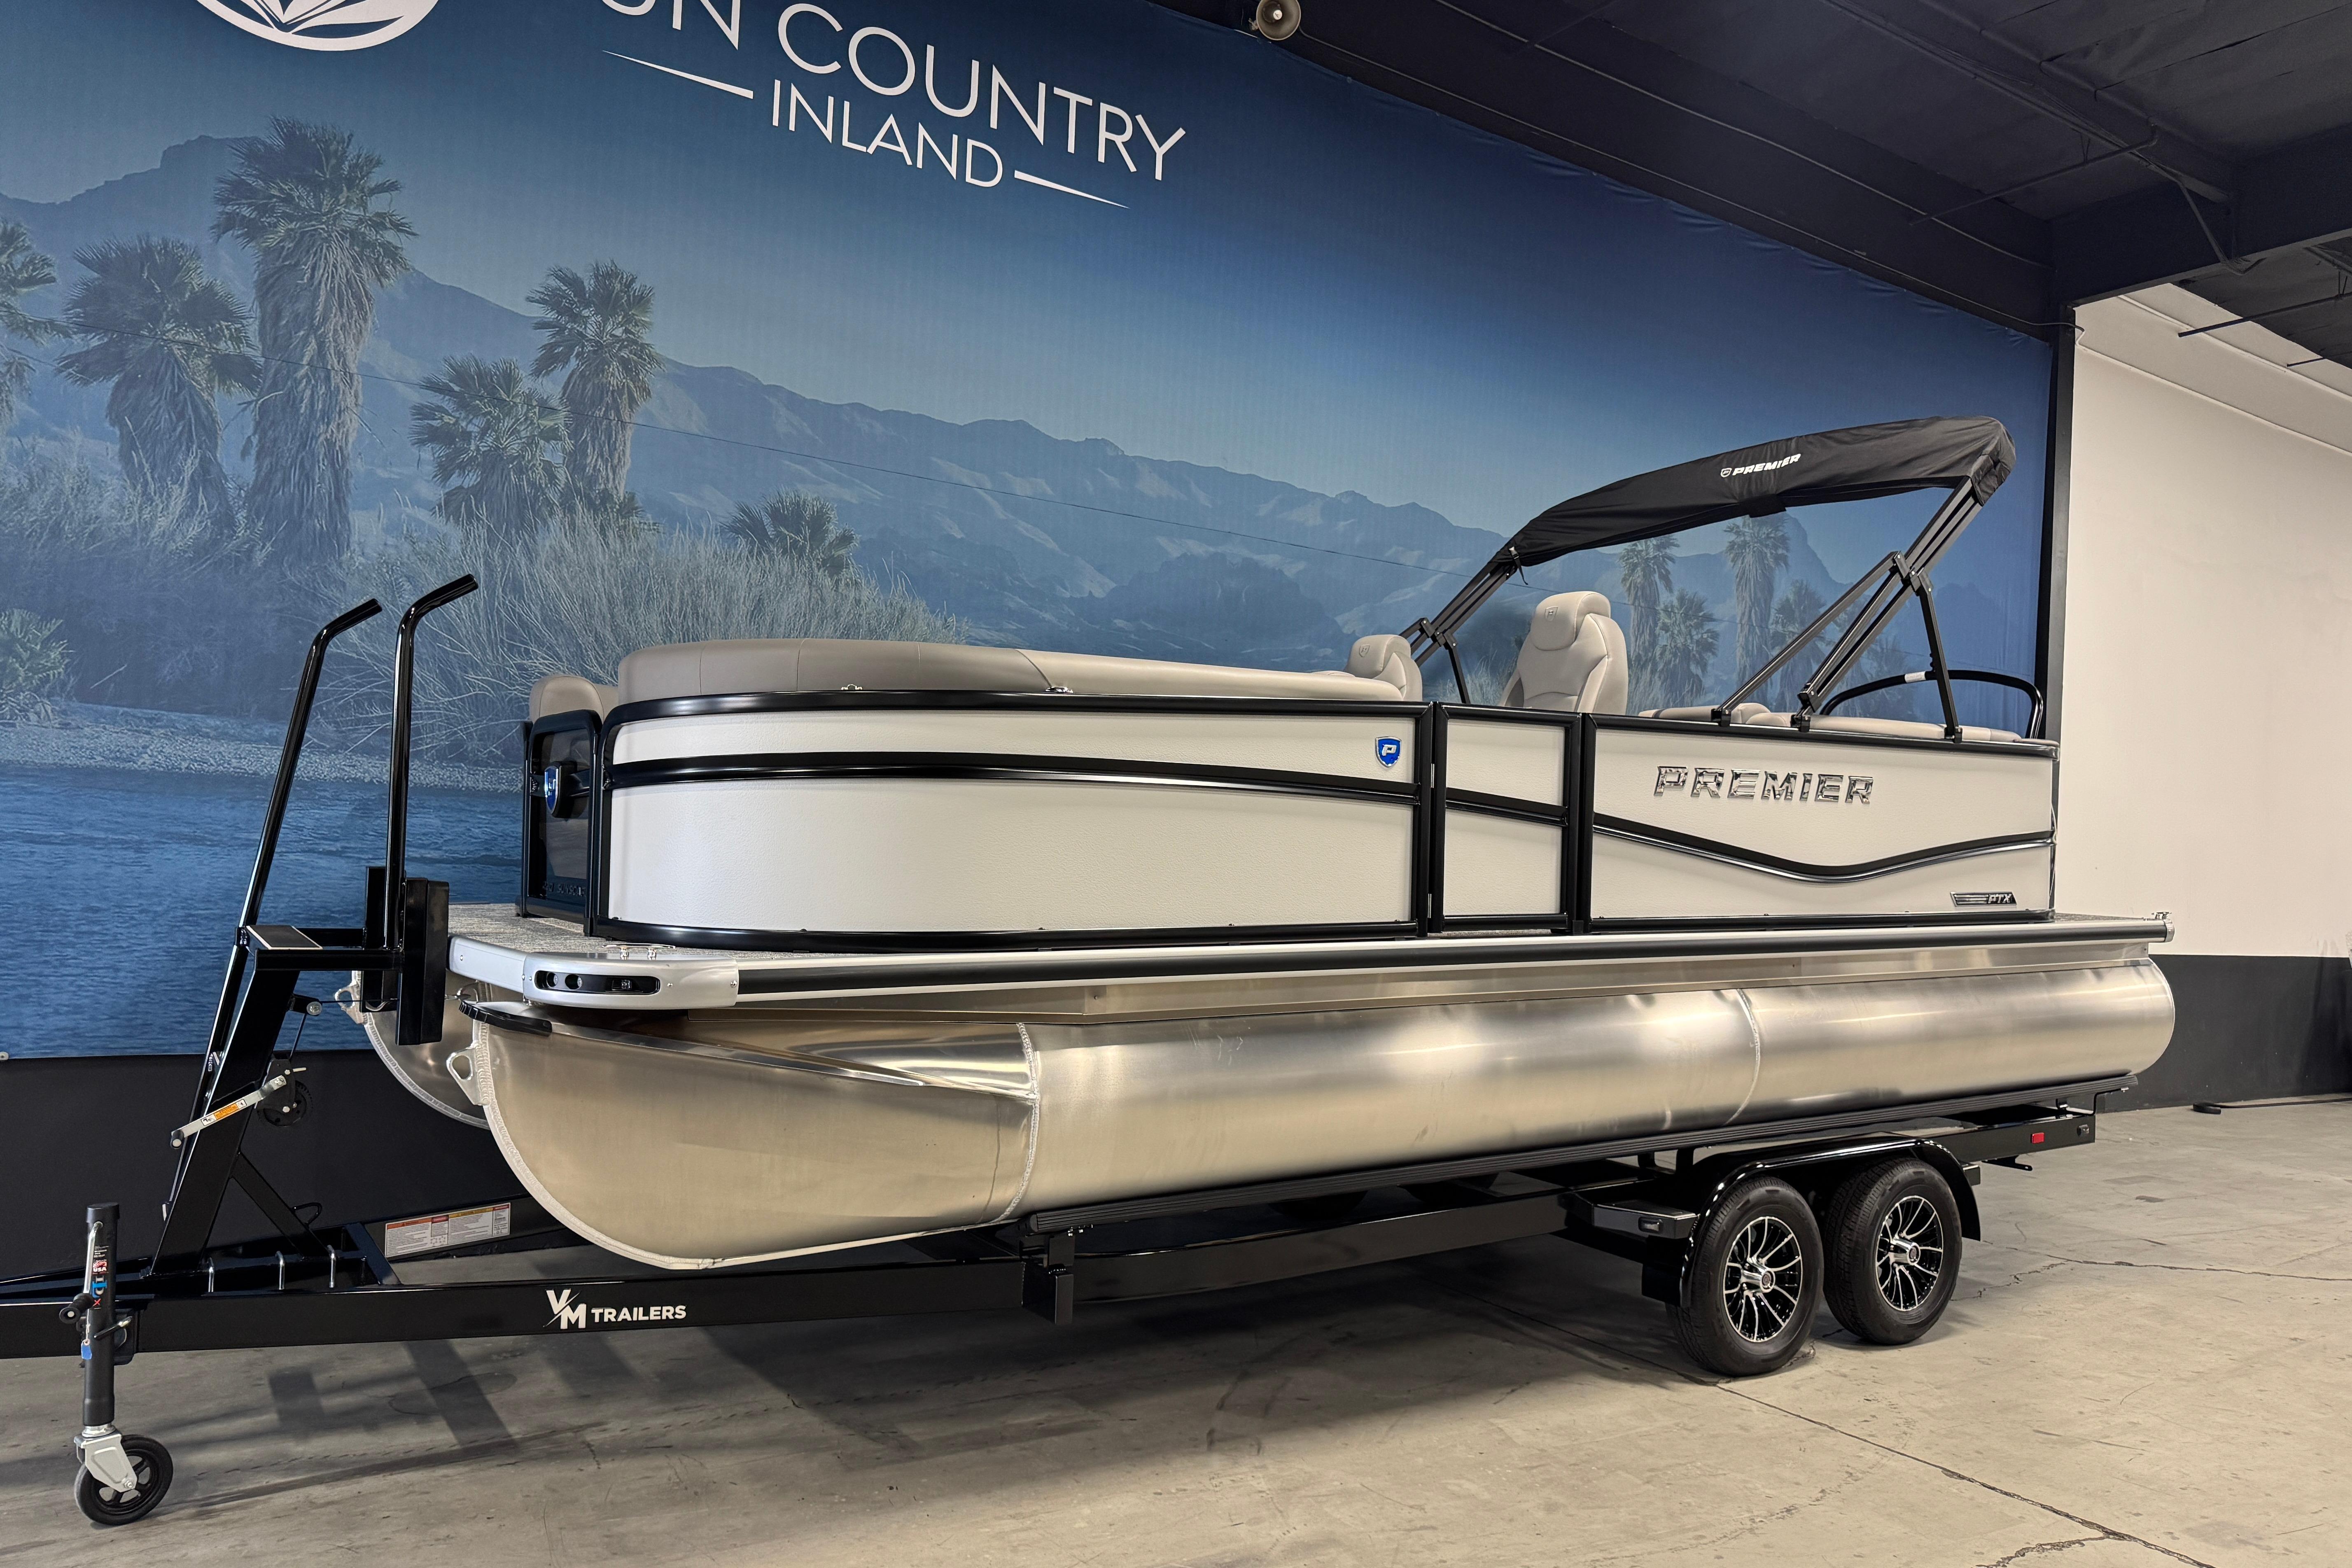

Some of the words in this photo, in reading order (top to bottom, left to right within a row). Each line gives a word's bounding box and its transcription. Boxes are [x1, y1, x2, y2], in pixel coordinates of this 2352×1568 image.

[778, 3, 1186, 181] COUNTRY
[772, 79, 1003, 187] INLAND
[1732, 453, 1801, 476] PREMIER
[1381, 744, 1397, 756] P
[1653, 765, 1874, 804] PREMIER
[1988, 894, 2012, 903] PTX
[591, 1305, 687, 1323] TRAILERS
